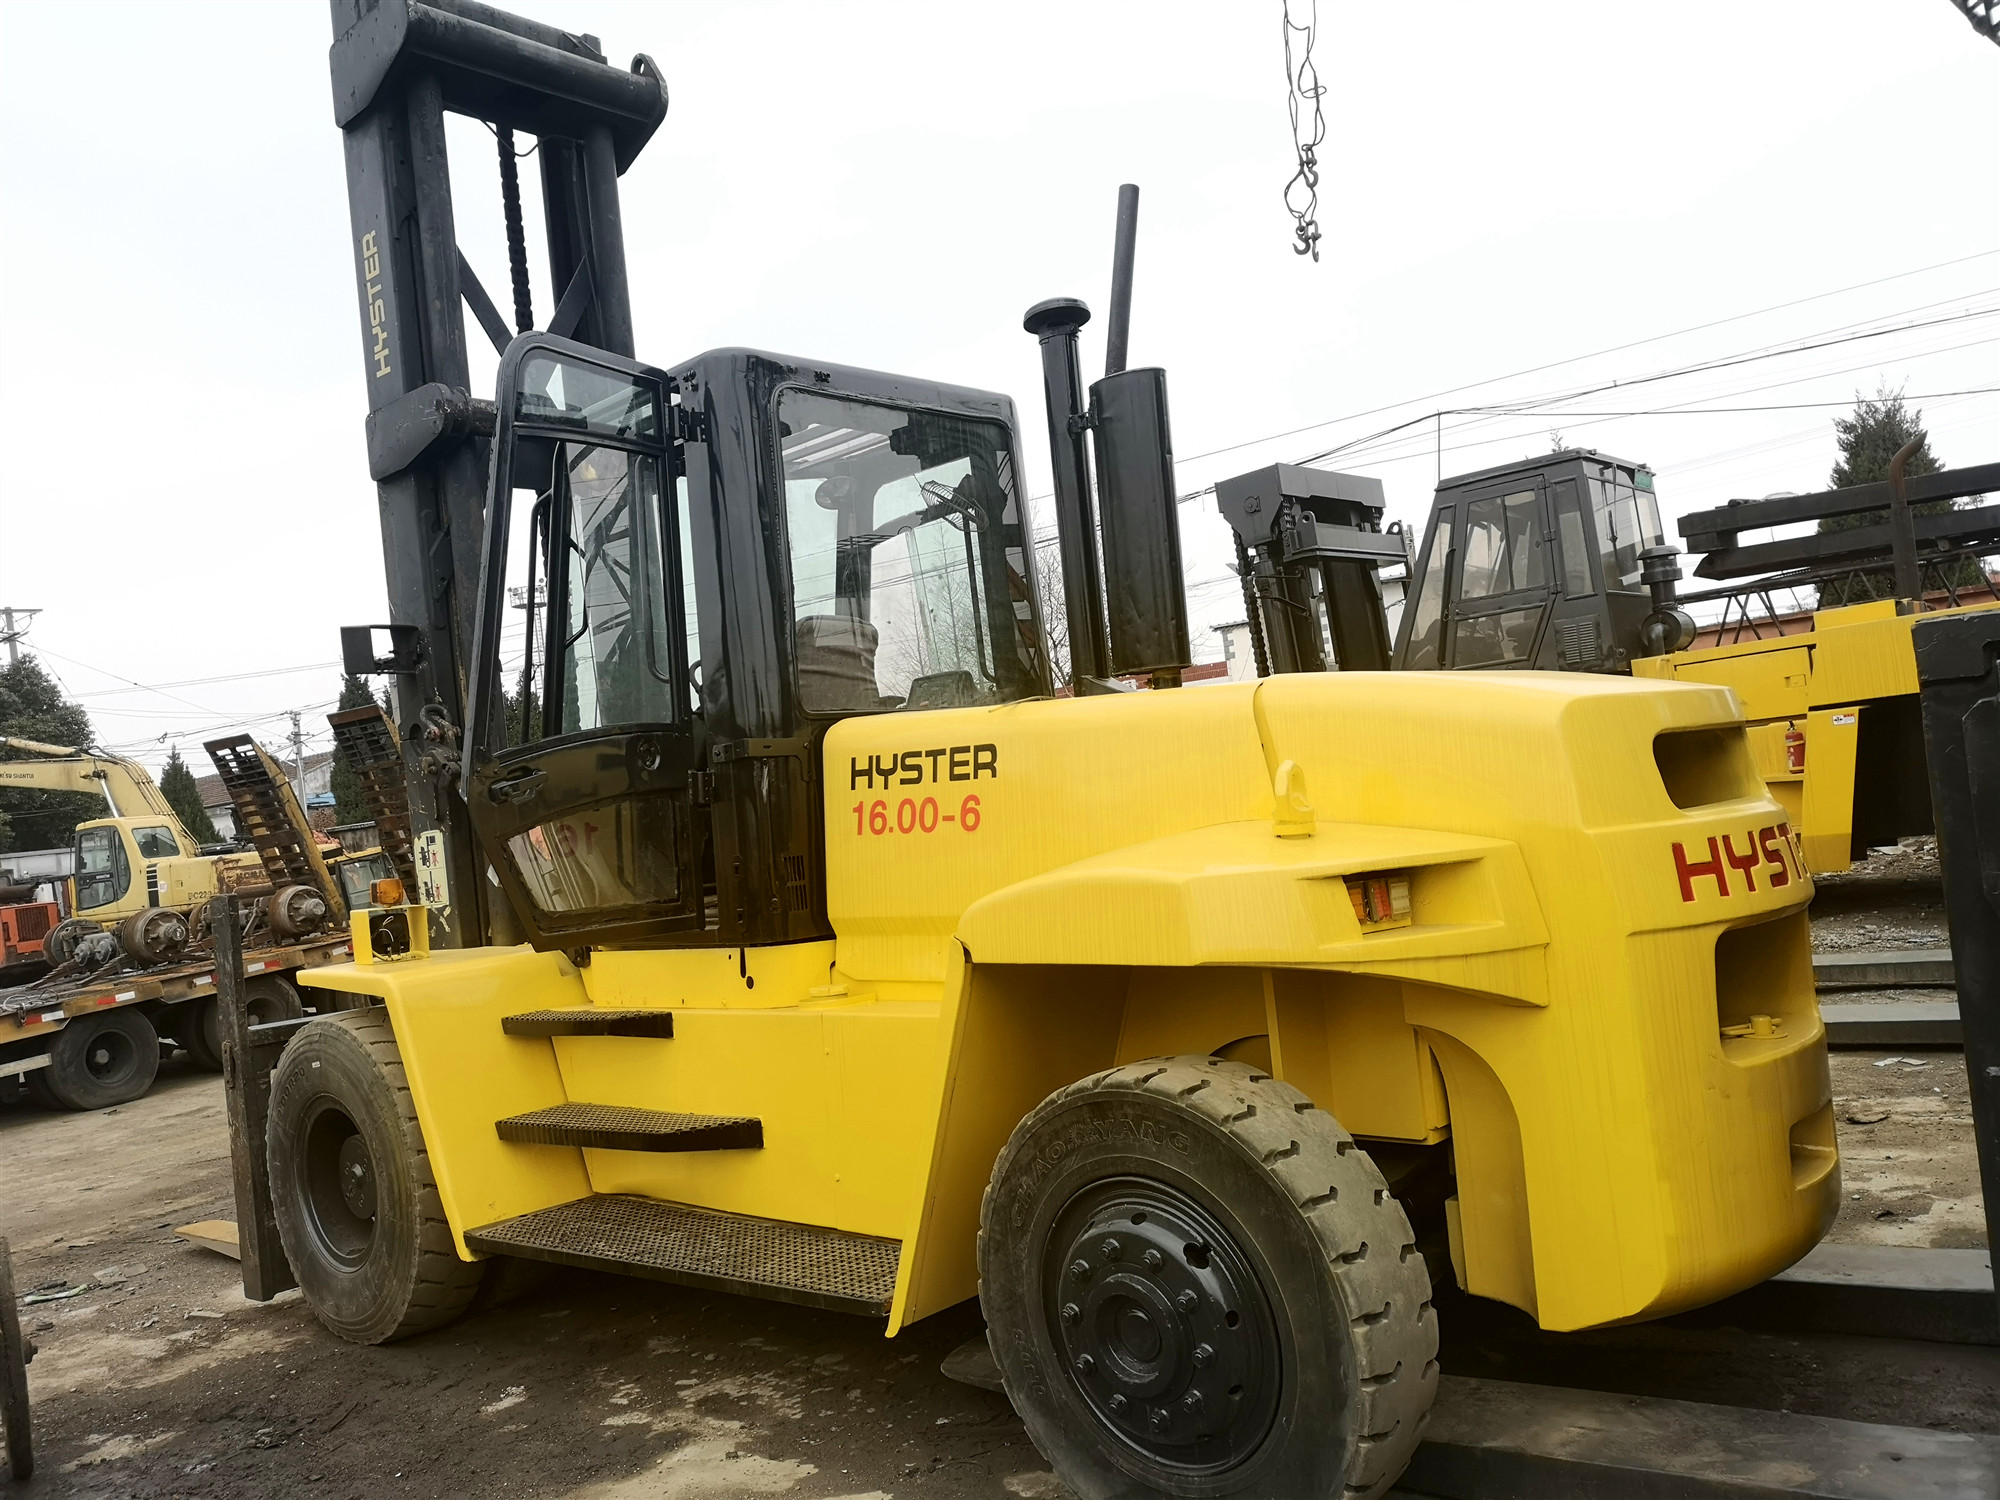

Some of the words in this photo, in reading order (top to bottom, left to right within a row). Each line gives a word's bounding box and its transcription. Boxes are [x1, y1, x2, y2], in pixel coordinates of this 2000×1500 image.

[362, 229, 391, 379] HYSTER
[850, 743, 997, 791] HYSTER
[852, 794, 981, 836] 16.00-6
[1671, 822, 1808, 902] HYST
